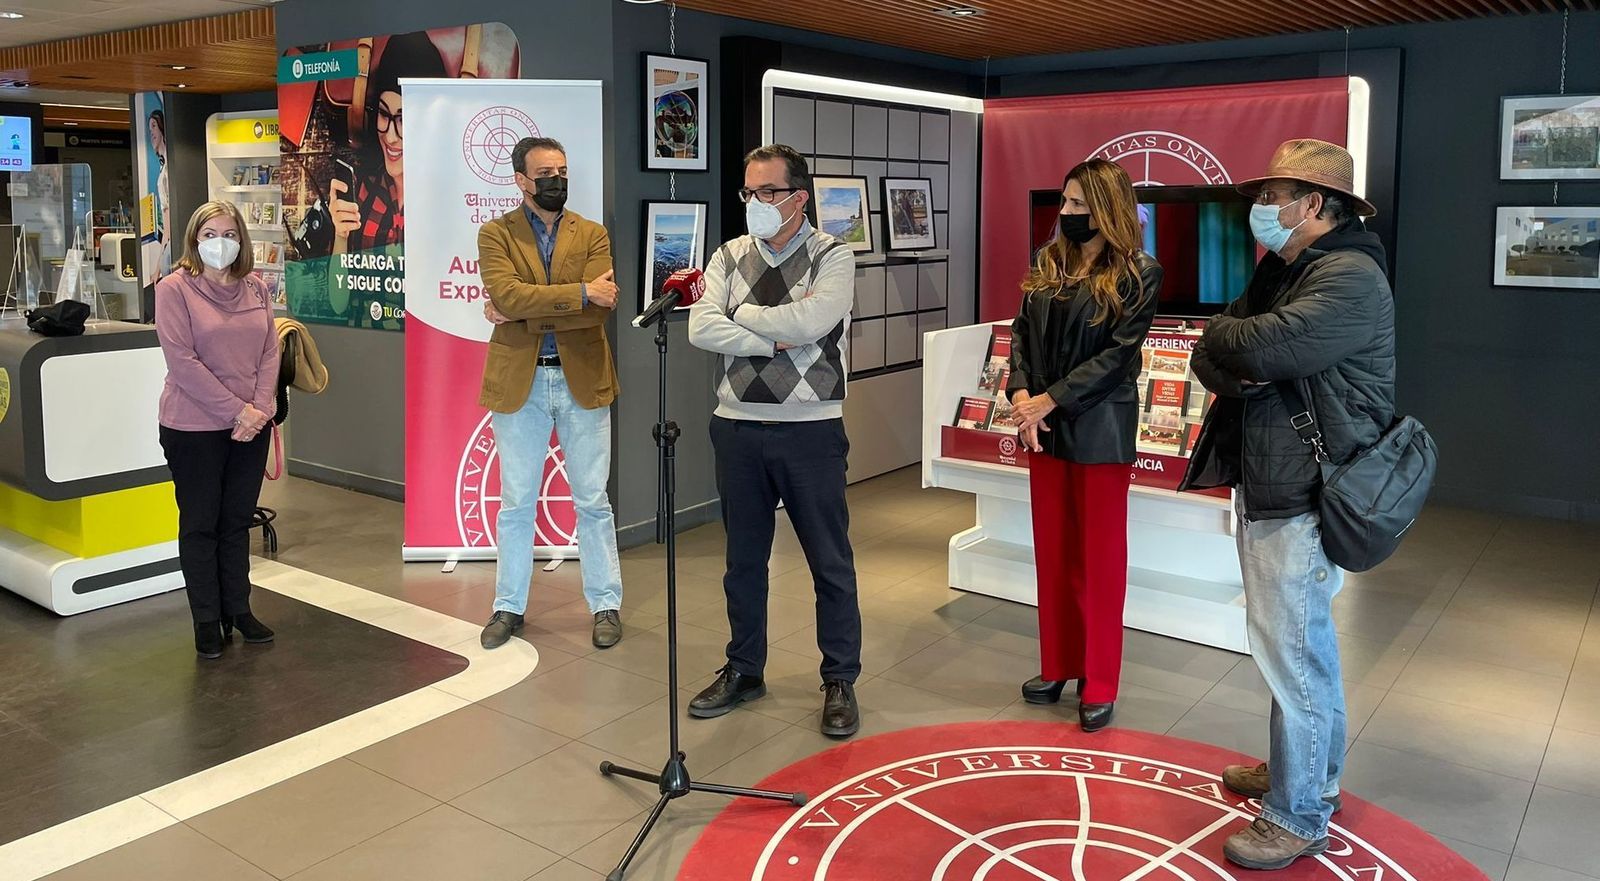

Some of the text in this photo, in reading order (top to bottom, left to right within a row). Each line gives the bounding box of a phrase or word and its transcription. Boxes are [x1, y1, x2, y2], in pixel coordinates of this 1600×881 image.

[304, 58, 340, 75] TELEFONÍA
[1096, 136, 1157, 162] ITAS
[470, 209, 488, 224] de
[340, 253, 395, 271] RECARGA
[336, 274, 344, 289] Y
[347, 275, 381, 292] SIGUE
[383, 306, 392, 317] TU
[463, 422, 494, 546] VNIVE
